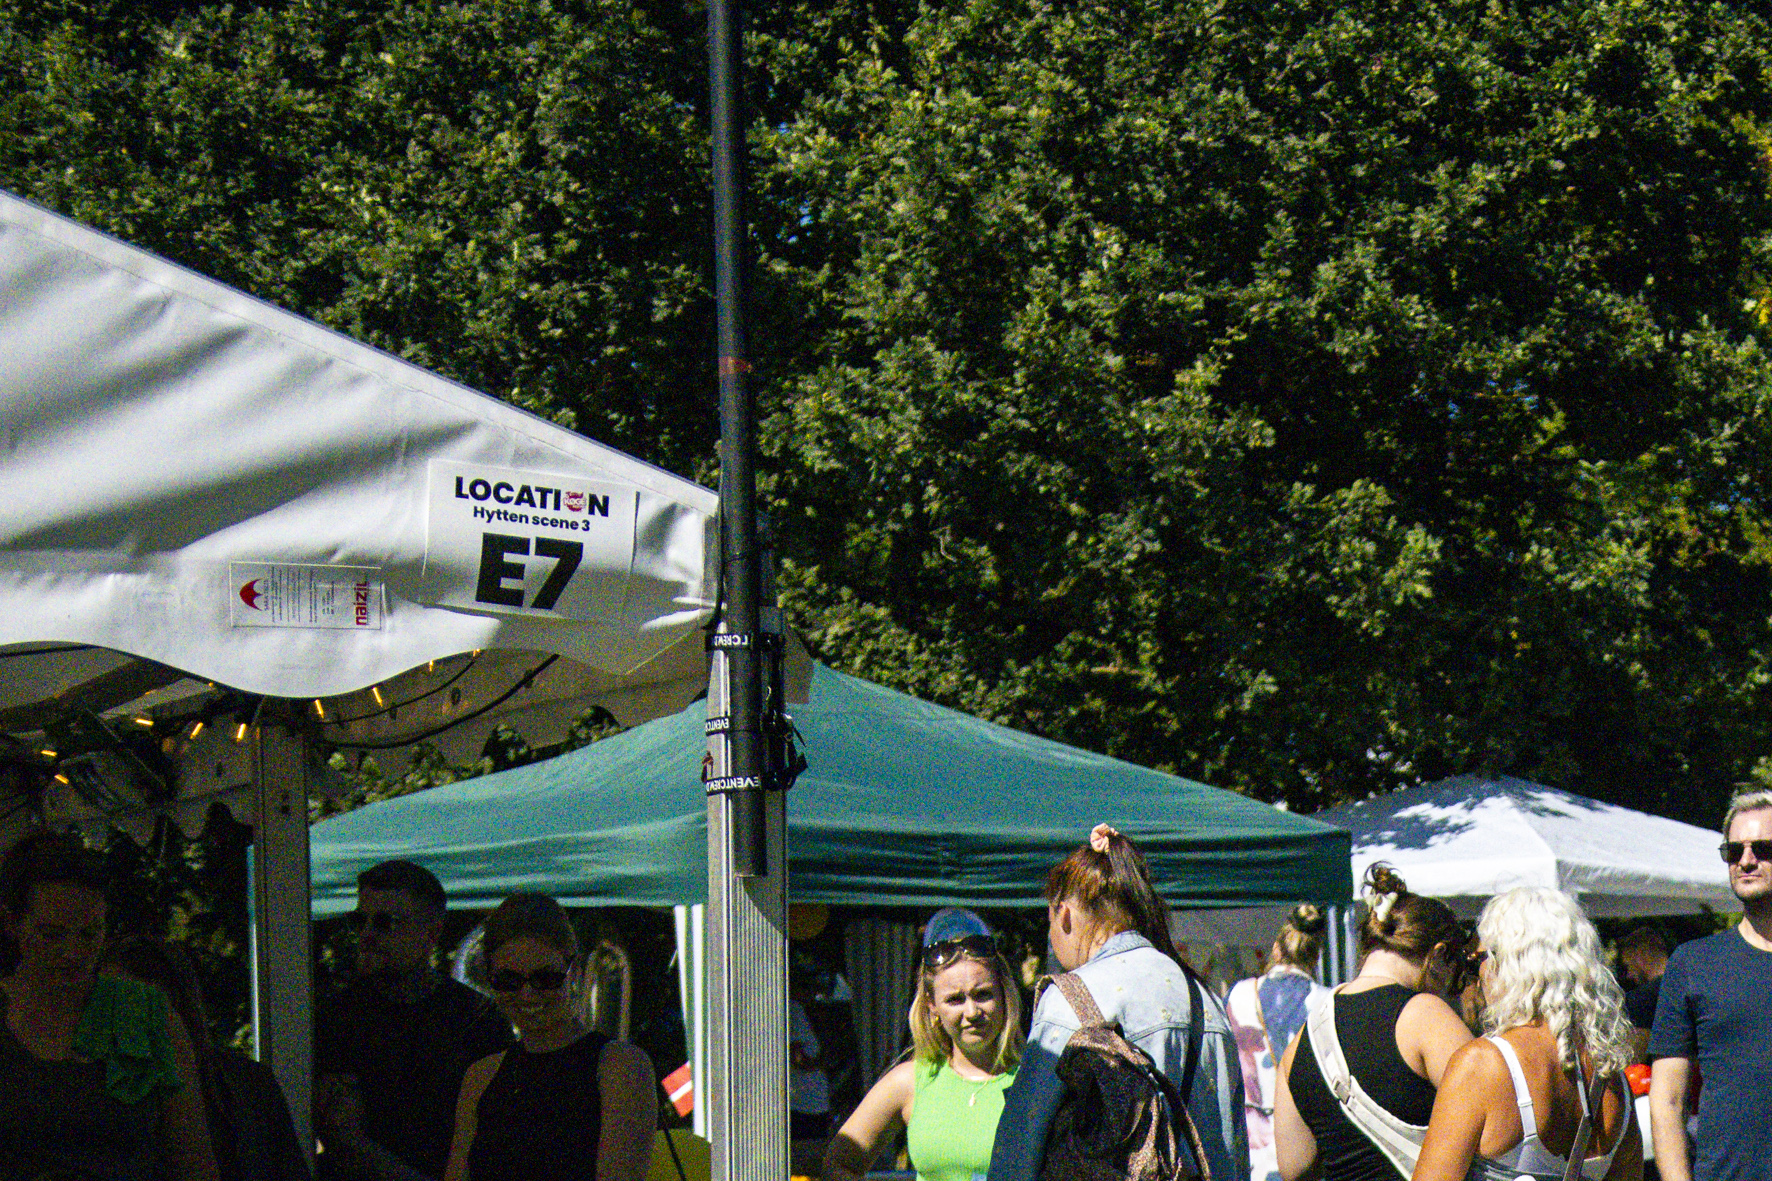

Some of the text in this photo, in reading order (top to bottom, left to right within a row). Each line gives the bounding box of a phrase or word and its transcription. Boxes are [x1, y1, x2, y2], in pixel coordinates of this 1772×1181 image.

[473, 505, 591, 532] Hytten scene 3
[475, 532, 584, 610] E7
